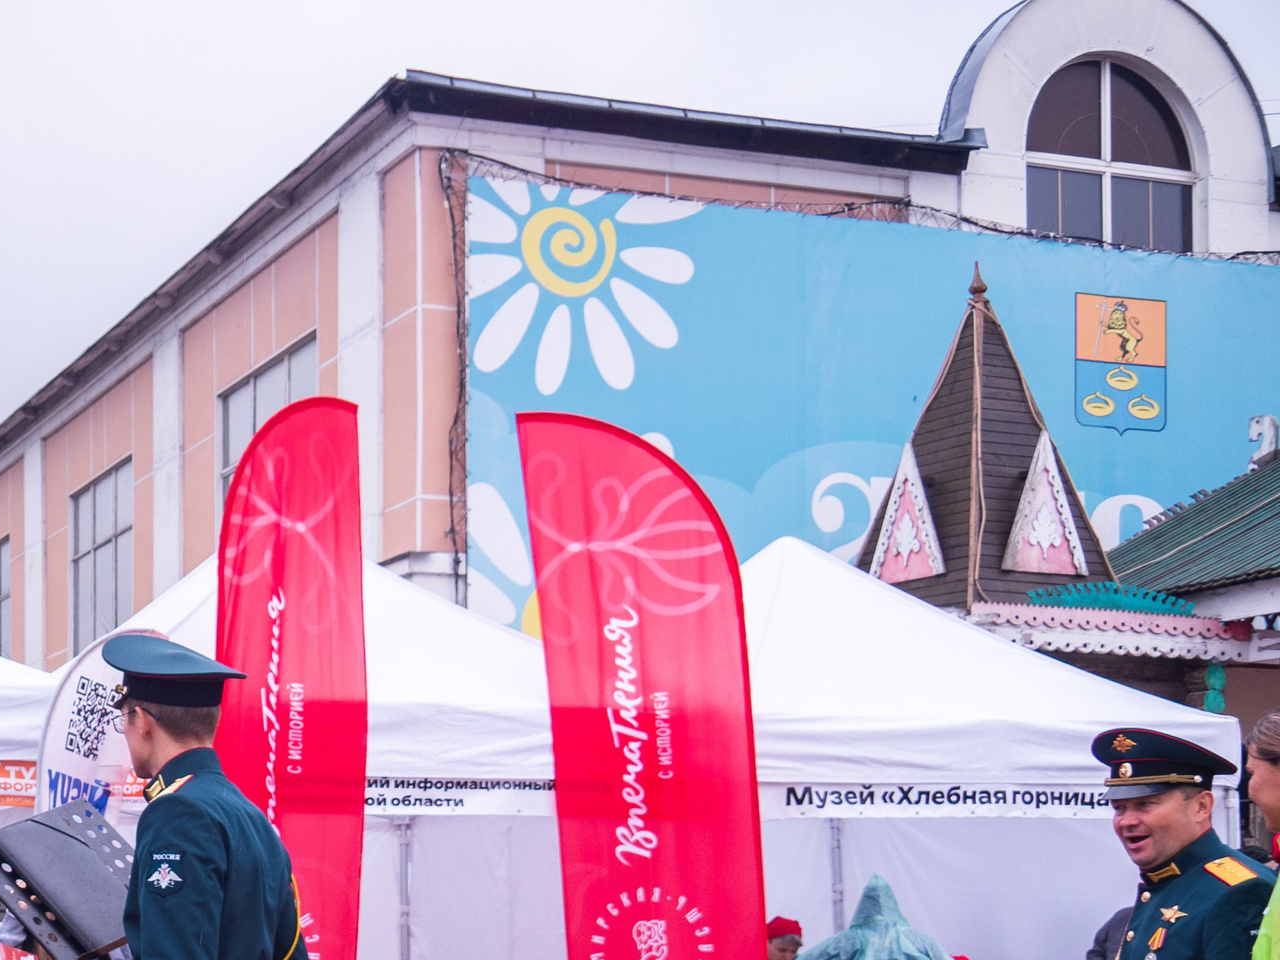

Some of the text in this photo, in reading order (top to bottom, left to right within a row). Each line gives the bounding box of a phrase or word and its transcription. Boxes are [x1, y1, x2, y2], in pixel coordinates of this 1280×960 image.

[285, 682, 305, 761] ИСТОРИЕЙ
[650, 691, 673, 766] ИСТОРИЕЙ
[394, 777, 556, 793] информационный
[391, 794, 465, 808] области
[785, 784, 875, 809] Музей
[882, 784, 1008, 806] «Хлебная
[152, 853, 181, 861] РОССИЯ
